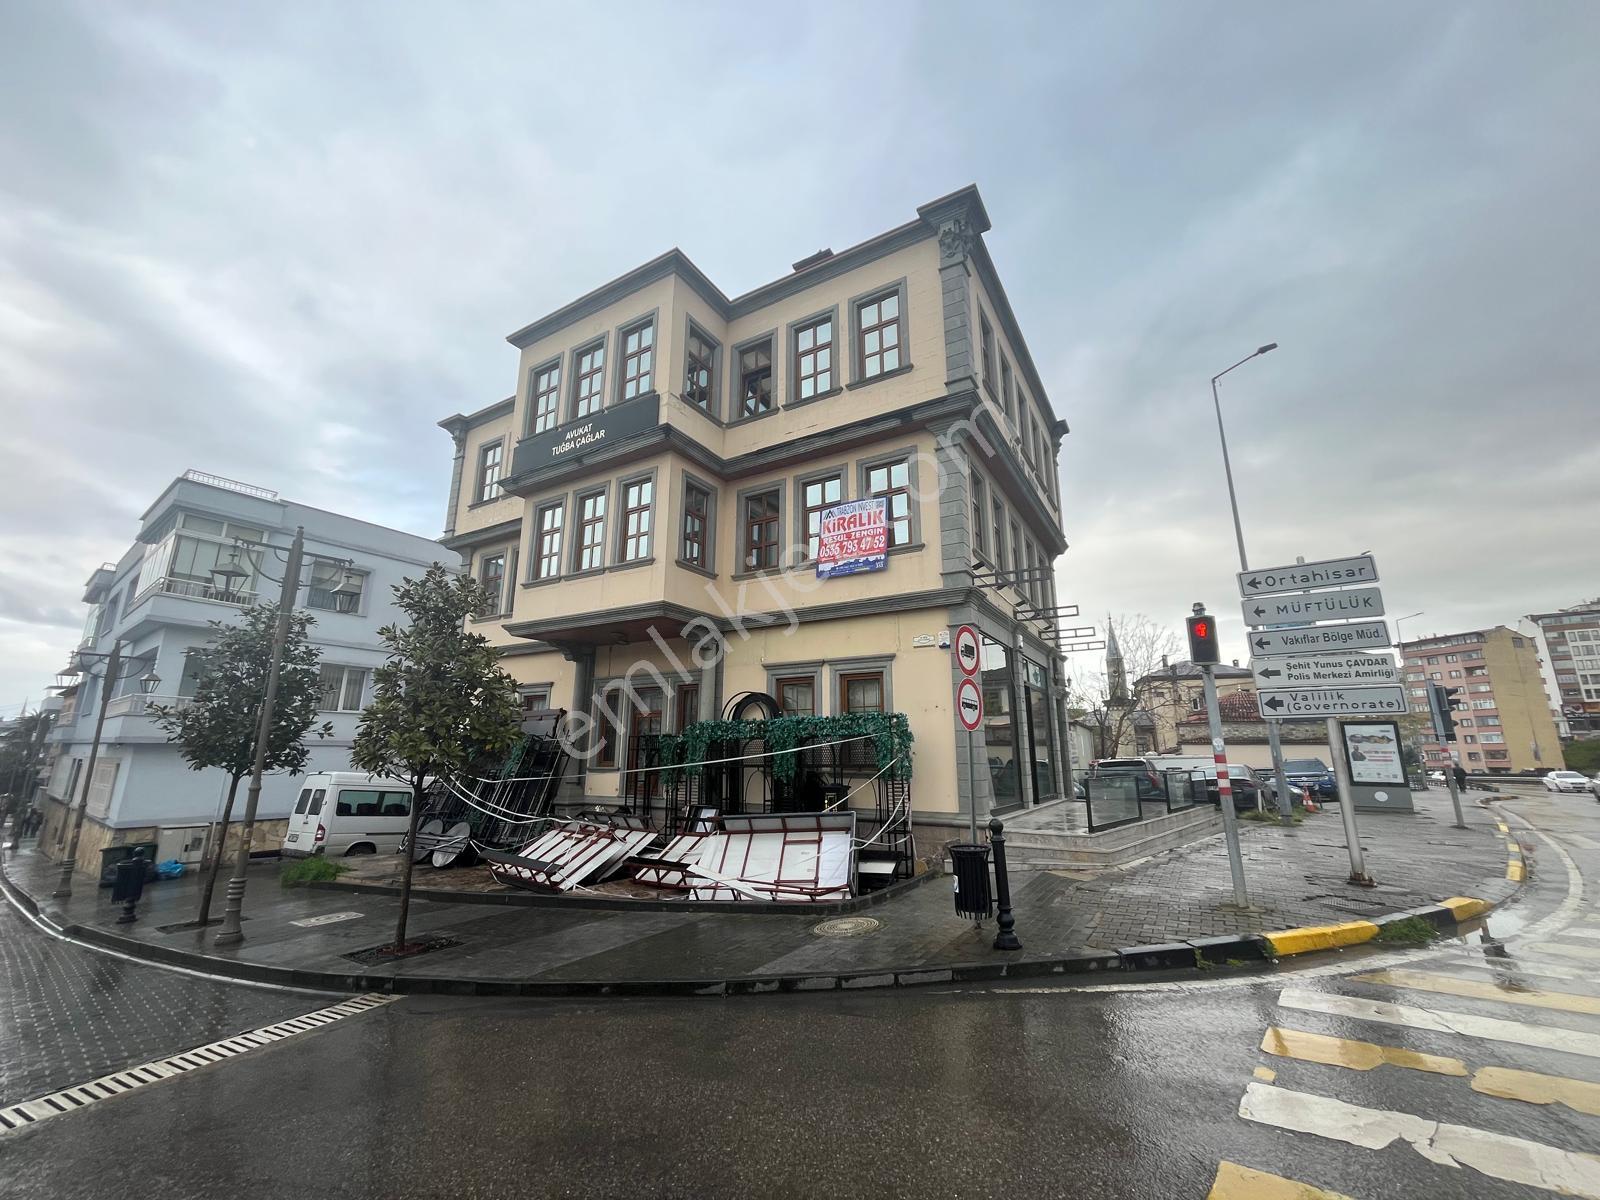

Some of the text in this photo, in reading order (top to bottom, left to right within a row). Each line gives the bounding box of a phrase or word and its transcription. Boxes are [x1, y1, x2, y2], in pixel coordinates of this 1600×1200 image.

[565, 423, 593, 440] AVUKAT
[552, 429, 606, 456] TUĞBA ÇAĞLAR
[873, 535, 885, 549] 52
[1264, 567, 1366, 587] Ortahisar
[1276, 596, 1374, 615] MÜFTÜLÜK
[1323, 631, 1354, 644] Bölge
[1356, 628, 1384, 639] Müd.
[1286, 658, 1389, 672] Şehit Yunus ÇAVDAR
[1287, 669, 1394, 681] Polis Merkezi Amirliği
[1289, 692, 1345, 702] Valilik
[1287, 699, 1402, 713] (Governorate)
